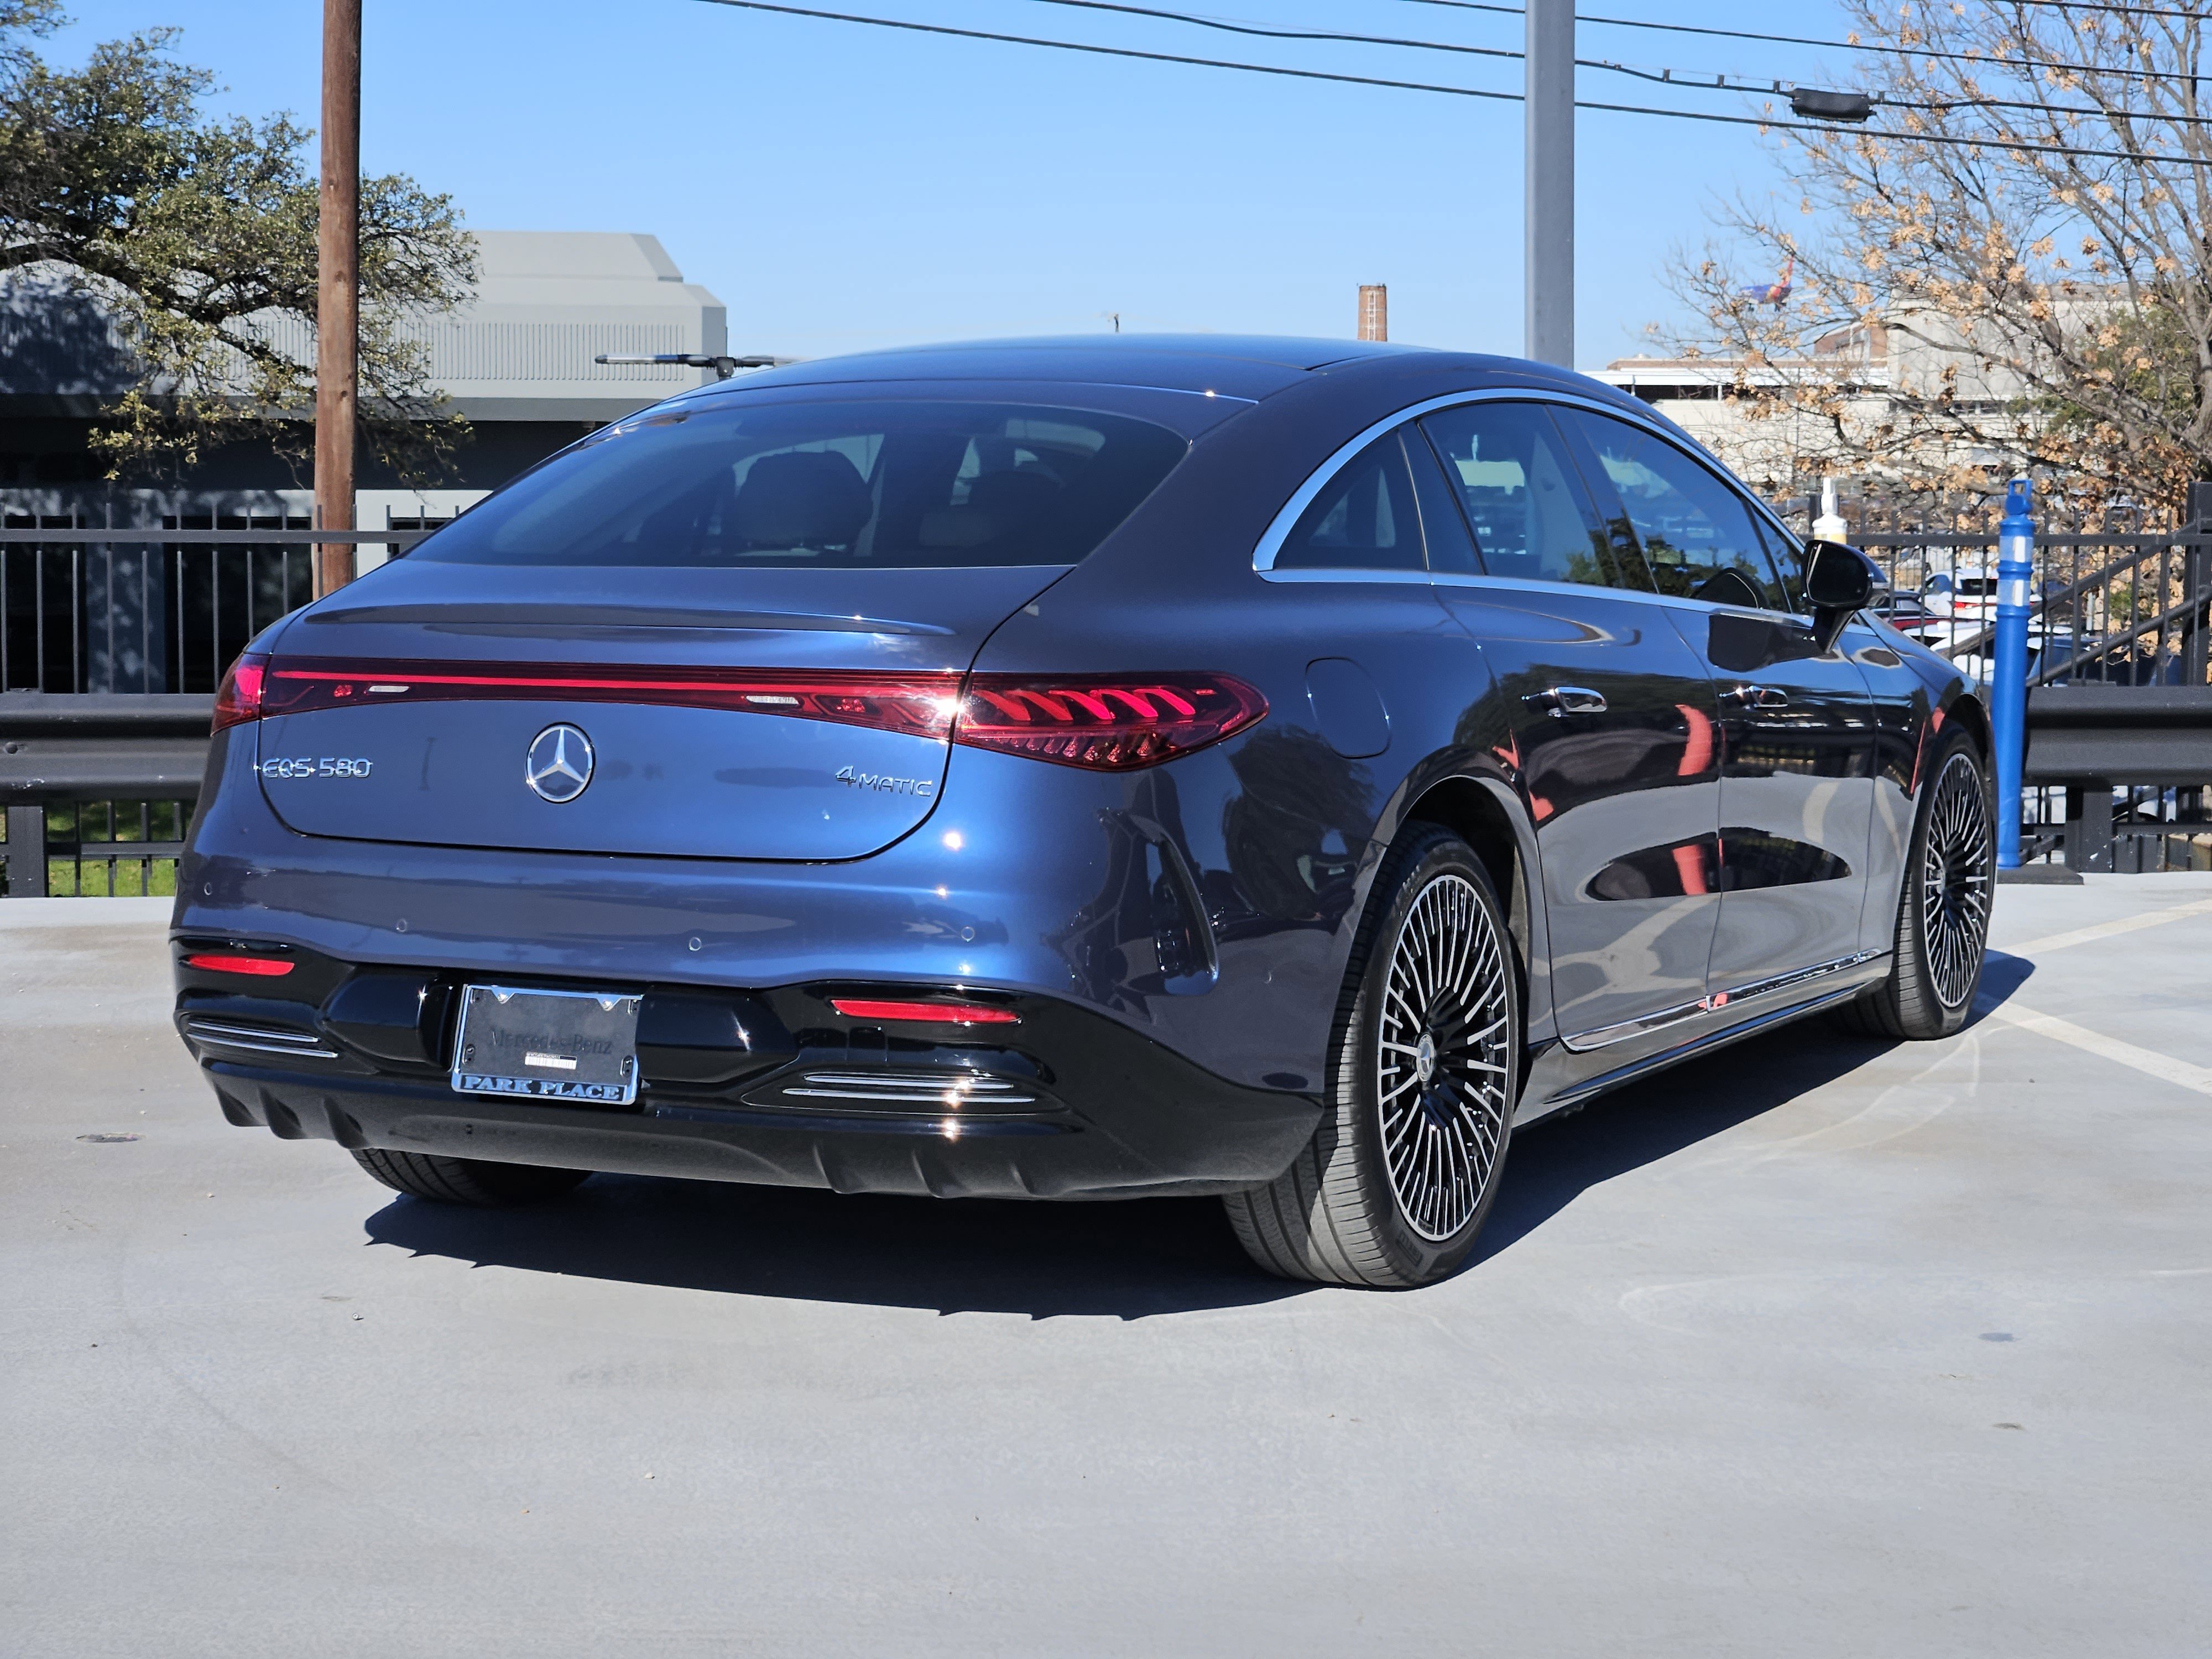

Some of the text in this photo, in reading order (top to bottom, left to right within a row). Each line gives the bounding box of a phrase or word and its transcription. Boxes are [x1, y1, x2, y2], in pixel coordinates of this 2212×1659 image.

[263, 758, 371, 778] EQS 580
[835, 765, 932, 796] 4MATIC
[465, 1076, 620, 1100] PARK PLACE
